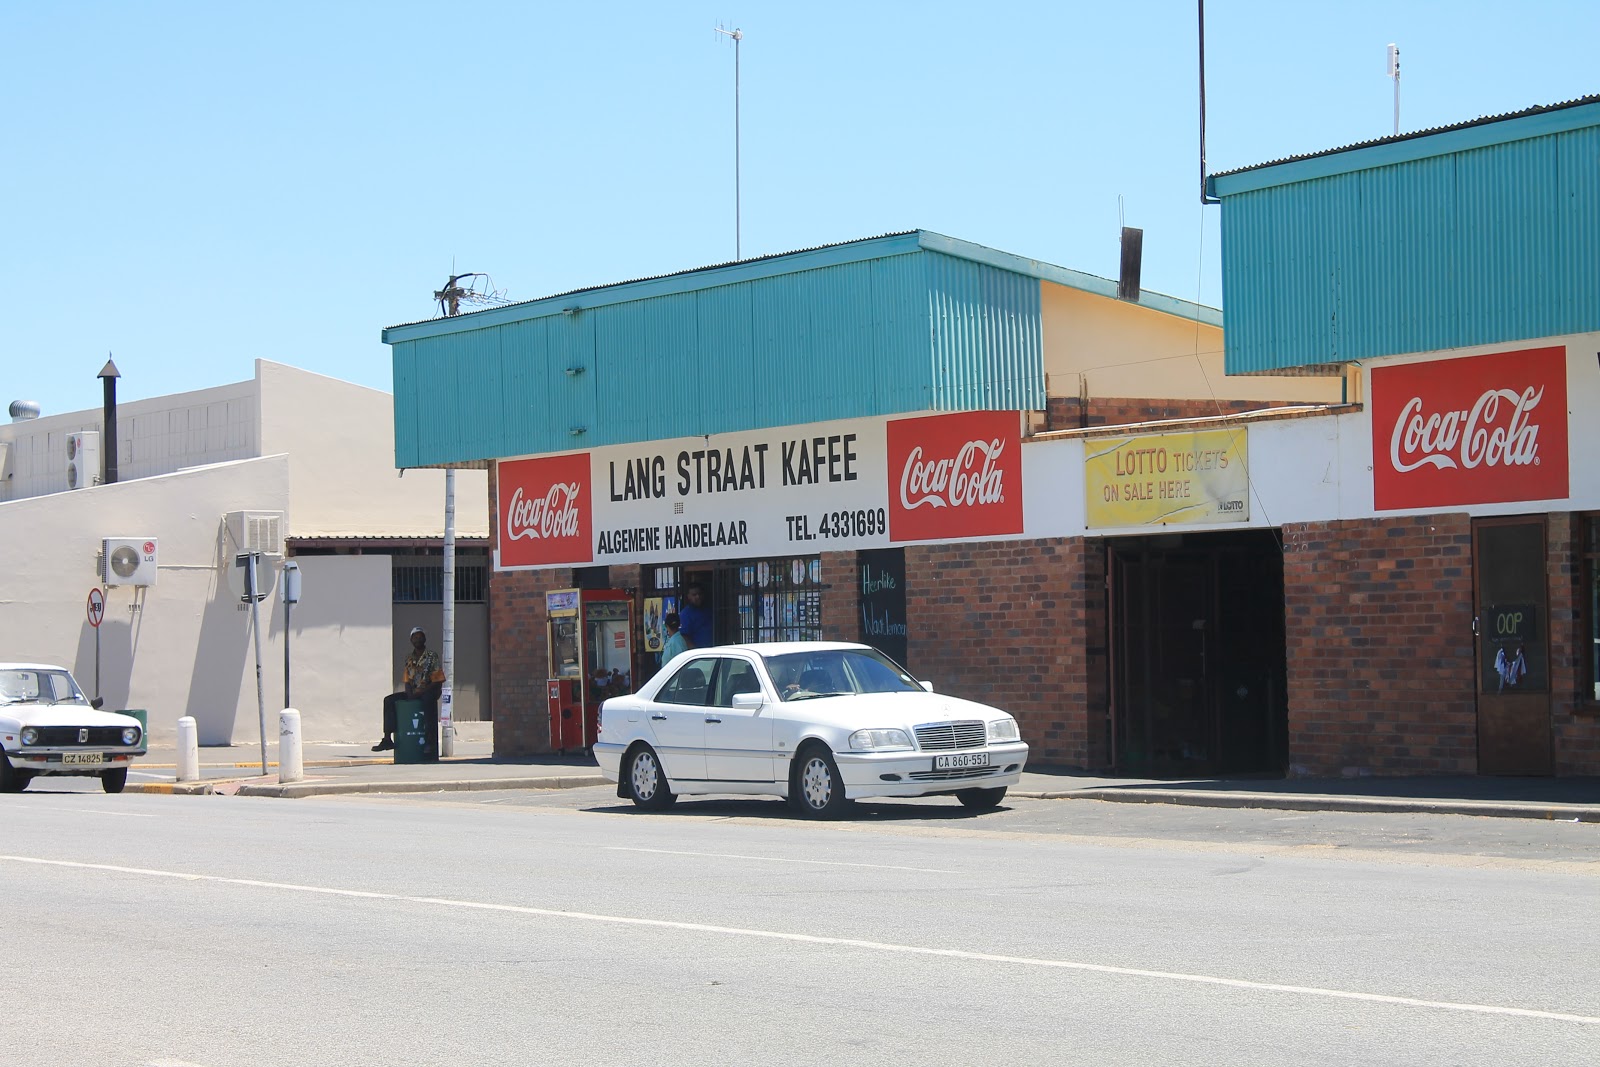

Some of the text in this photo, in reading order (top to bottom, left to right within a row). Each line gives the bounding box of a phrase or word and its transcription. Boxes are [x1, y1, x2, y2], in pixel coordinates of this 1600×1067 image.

[1390, 384, 1545, 473] Coca-Cola
[609, 433, 858, 502] LANG STRAAT KAFEE
[899, 437, 1006, 510] Coca-Cola
[1116, 447, 1229, 476] LOTTO TICKETS
[1103, 479, 1191, 502] ON SALE HERE
[507, 482, 581, 541] Coca-Cola
[786, 507, 886, 542] TEL. 4331699
[597, 520, 748, 555] ALGEMENE HANDELAAR
[1497, 612, 1523, 634] OOP
[64, 754, 101, 764] CZ 14825
[938, 754, 987, 768] CA 860-551
